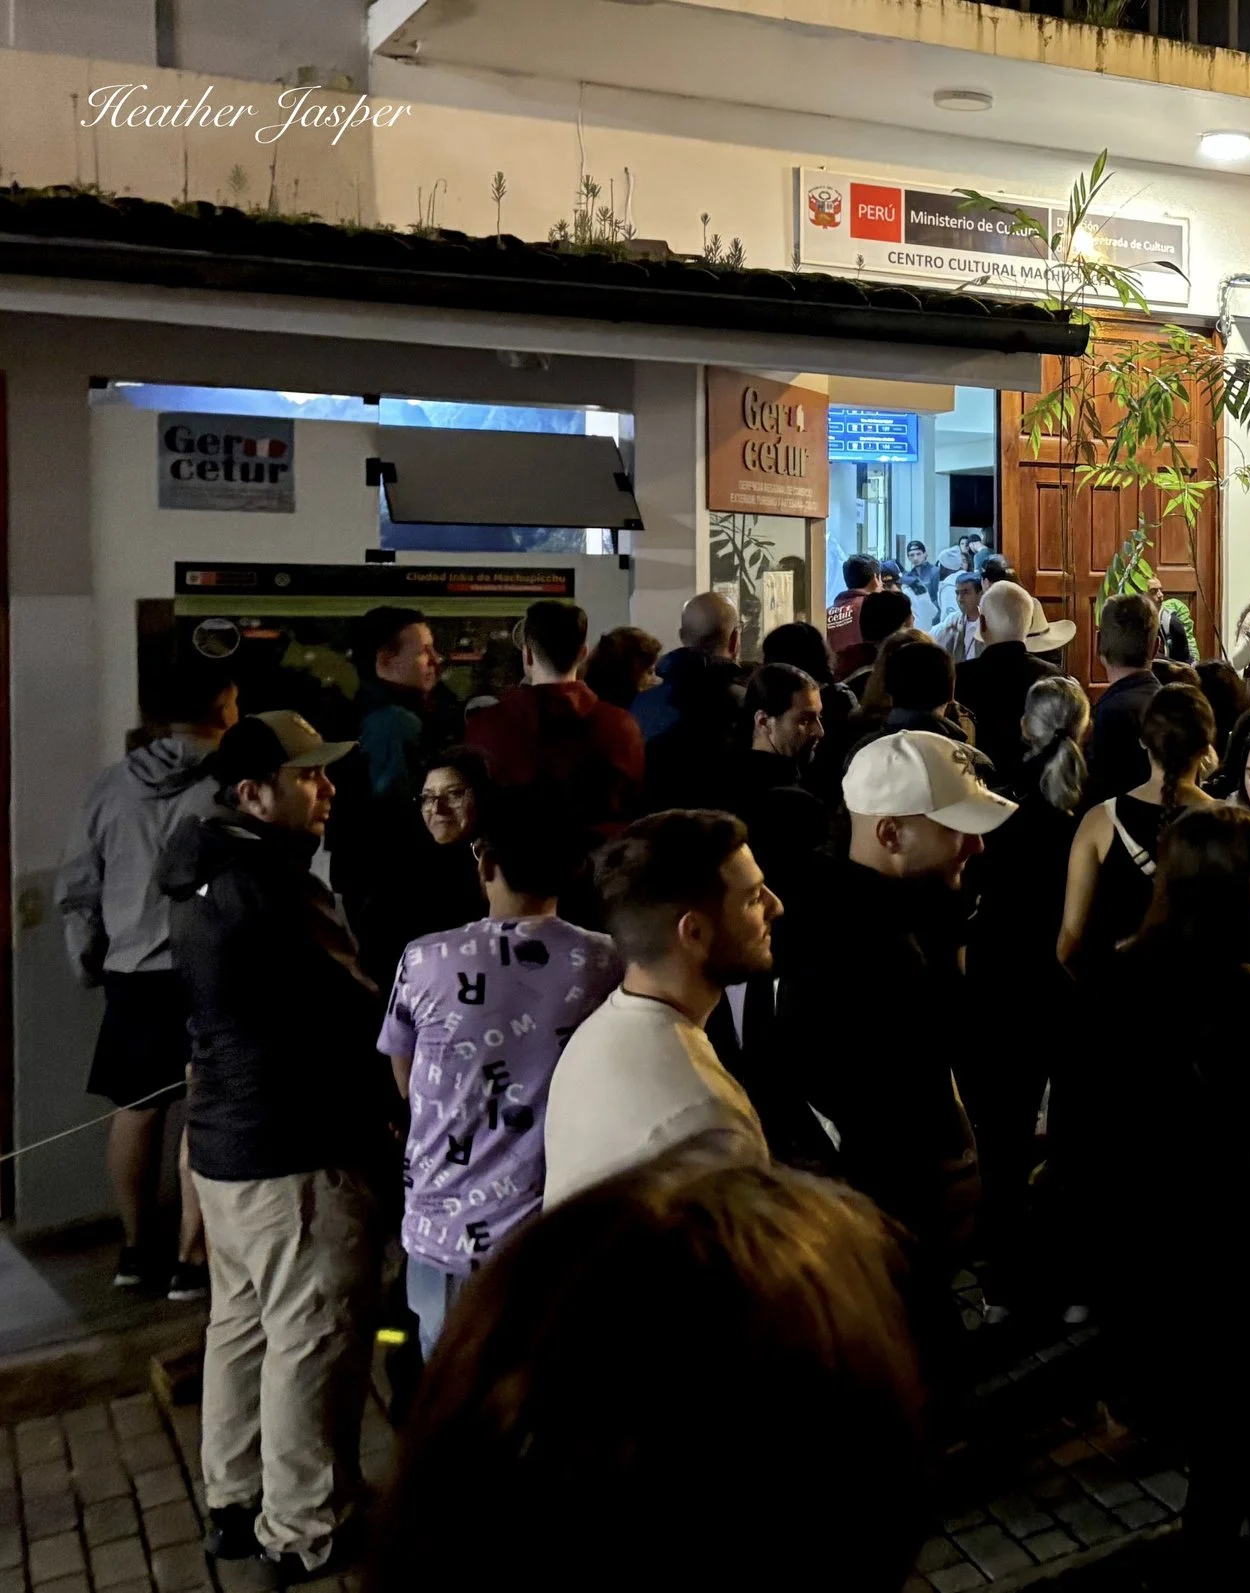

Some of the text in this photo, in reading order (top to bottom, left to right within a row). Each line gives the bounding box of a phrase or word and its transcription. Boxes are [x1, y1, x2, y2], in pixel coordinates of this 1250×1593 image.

[858, 204, 896, 222] PERÚ
[910, 210, 975, 231] Ministerio
[977, 218, 993, 233] de
[1130, 239, 1142, 250] de
[1143, 240, 1175, 253] Cultura
[888, 251, 944, 269] CENTRO
[949, 258, 1016, 277] CULTURAL
[743, 437, 809, 477] cetur
[170, 456, 288, 483] cetur
